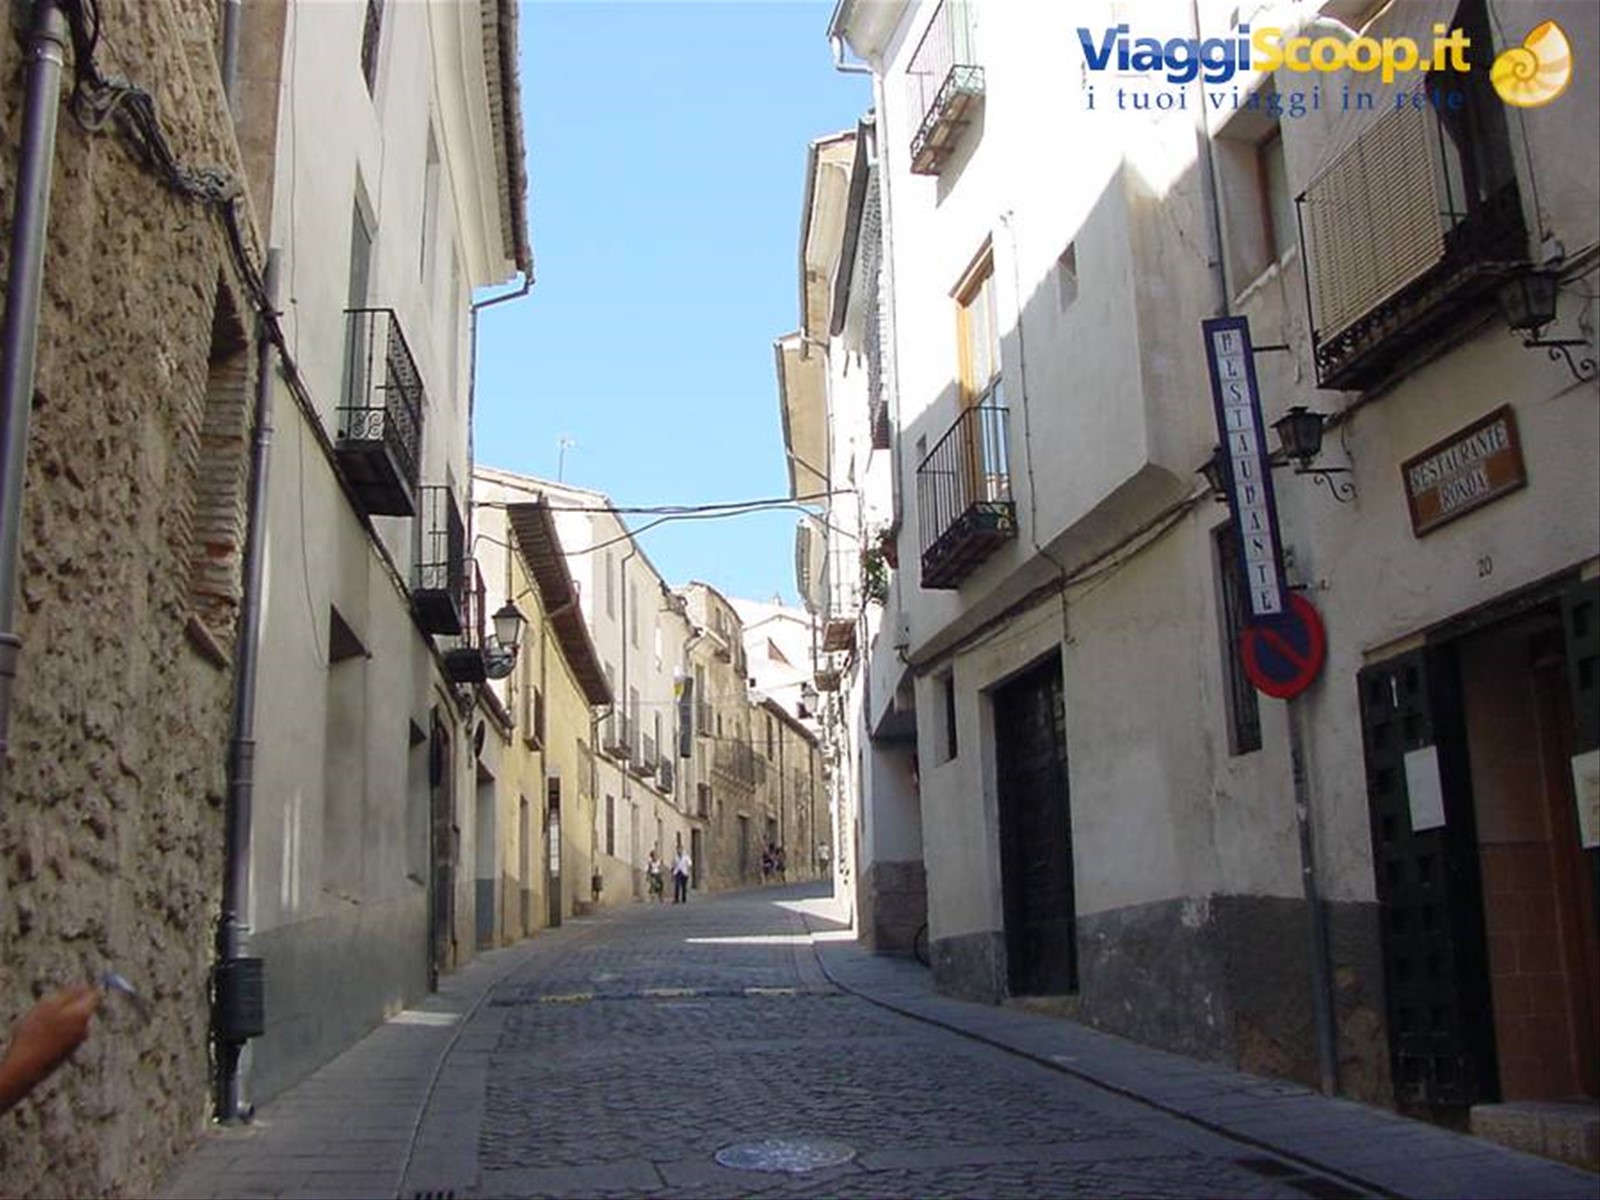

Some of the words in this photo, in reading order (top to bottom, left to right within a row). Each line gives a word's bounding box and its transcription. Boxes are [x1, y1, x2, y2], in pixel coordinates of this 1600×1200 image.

[1408, 420, 1509, 489] RESTAURANTE
[1441, 469, 1487, 513] RONDA
[1477, 555, 1494, 578] 20
